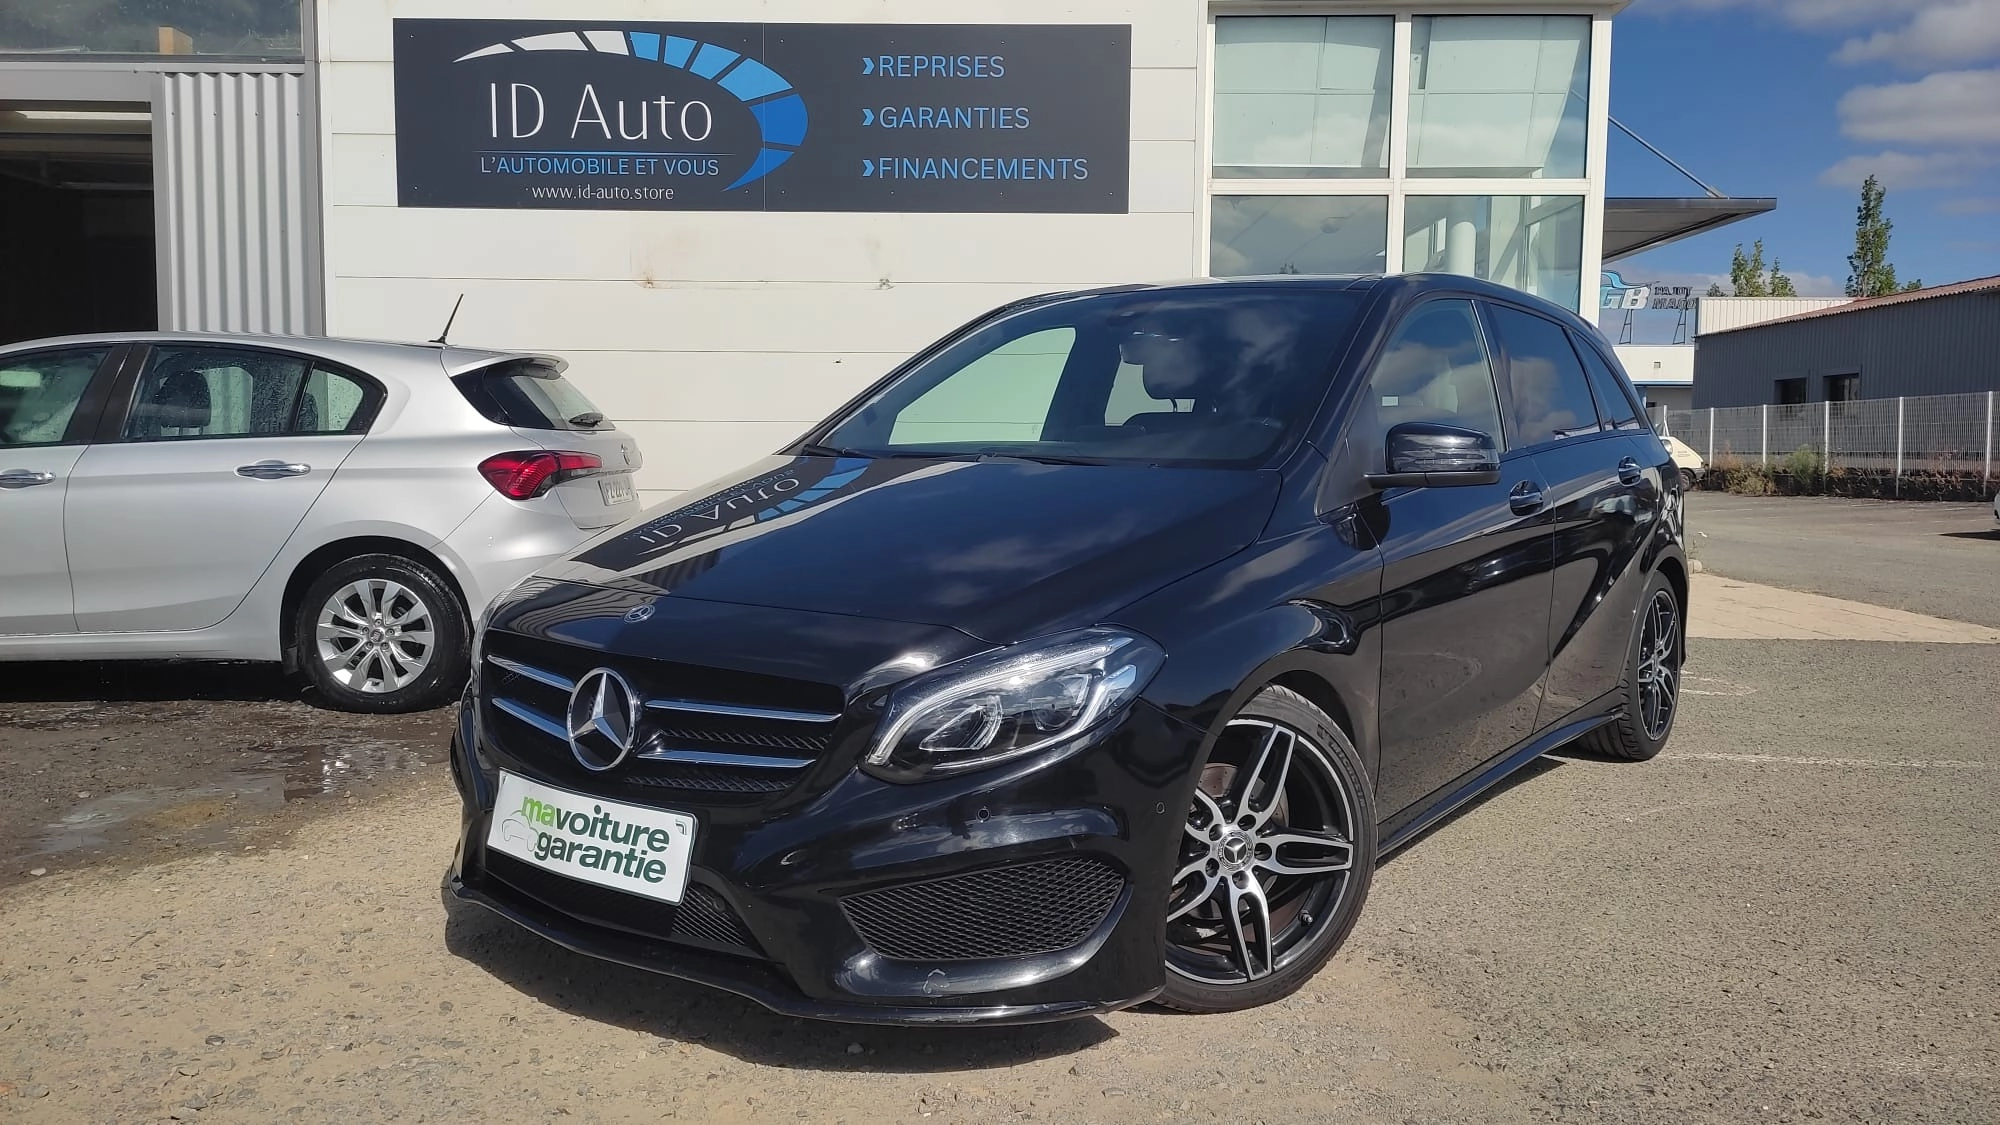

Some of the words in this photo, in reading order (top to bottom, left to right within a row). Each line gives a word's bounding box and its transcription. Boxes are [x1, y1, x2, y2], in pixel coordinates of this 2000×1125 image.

[879, 55, 1005, 78] REPRISES
[491, 82, 545, 138] ID
[571, 83, 712, 141] Auto
[879, 106, 1030, 129] GARANTIES
[480, 156, 630, 175] L'AUTOMOBILE
[636, 158, 657, 176] ET
[666, 158, 720, 176] VOUS
[879, 157, 1089, 180] FINANCEMENTS
[531, 183, 674, 201] www.id-auto.store
[534, 831, 667, 884] garantie
